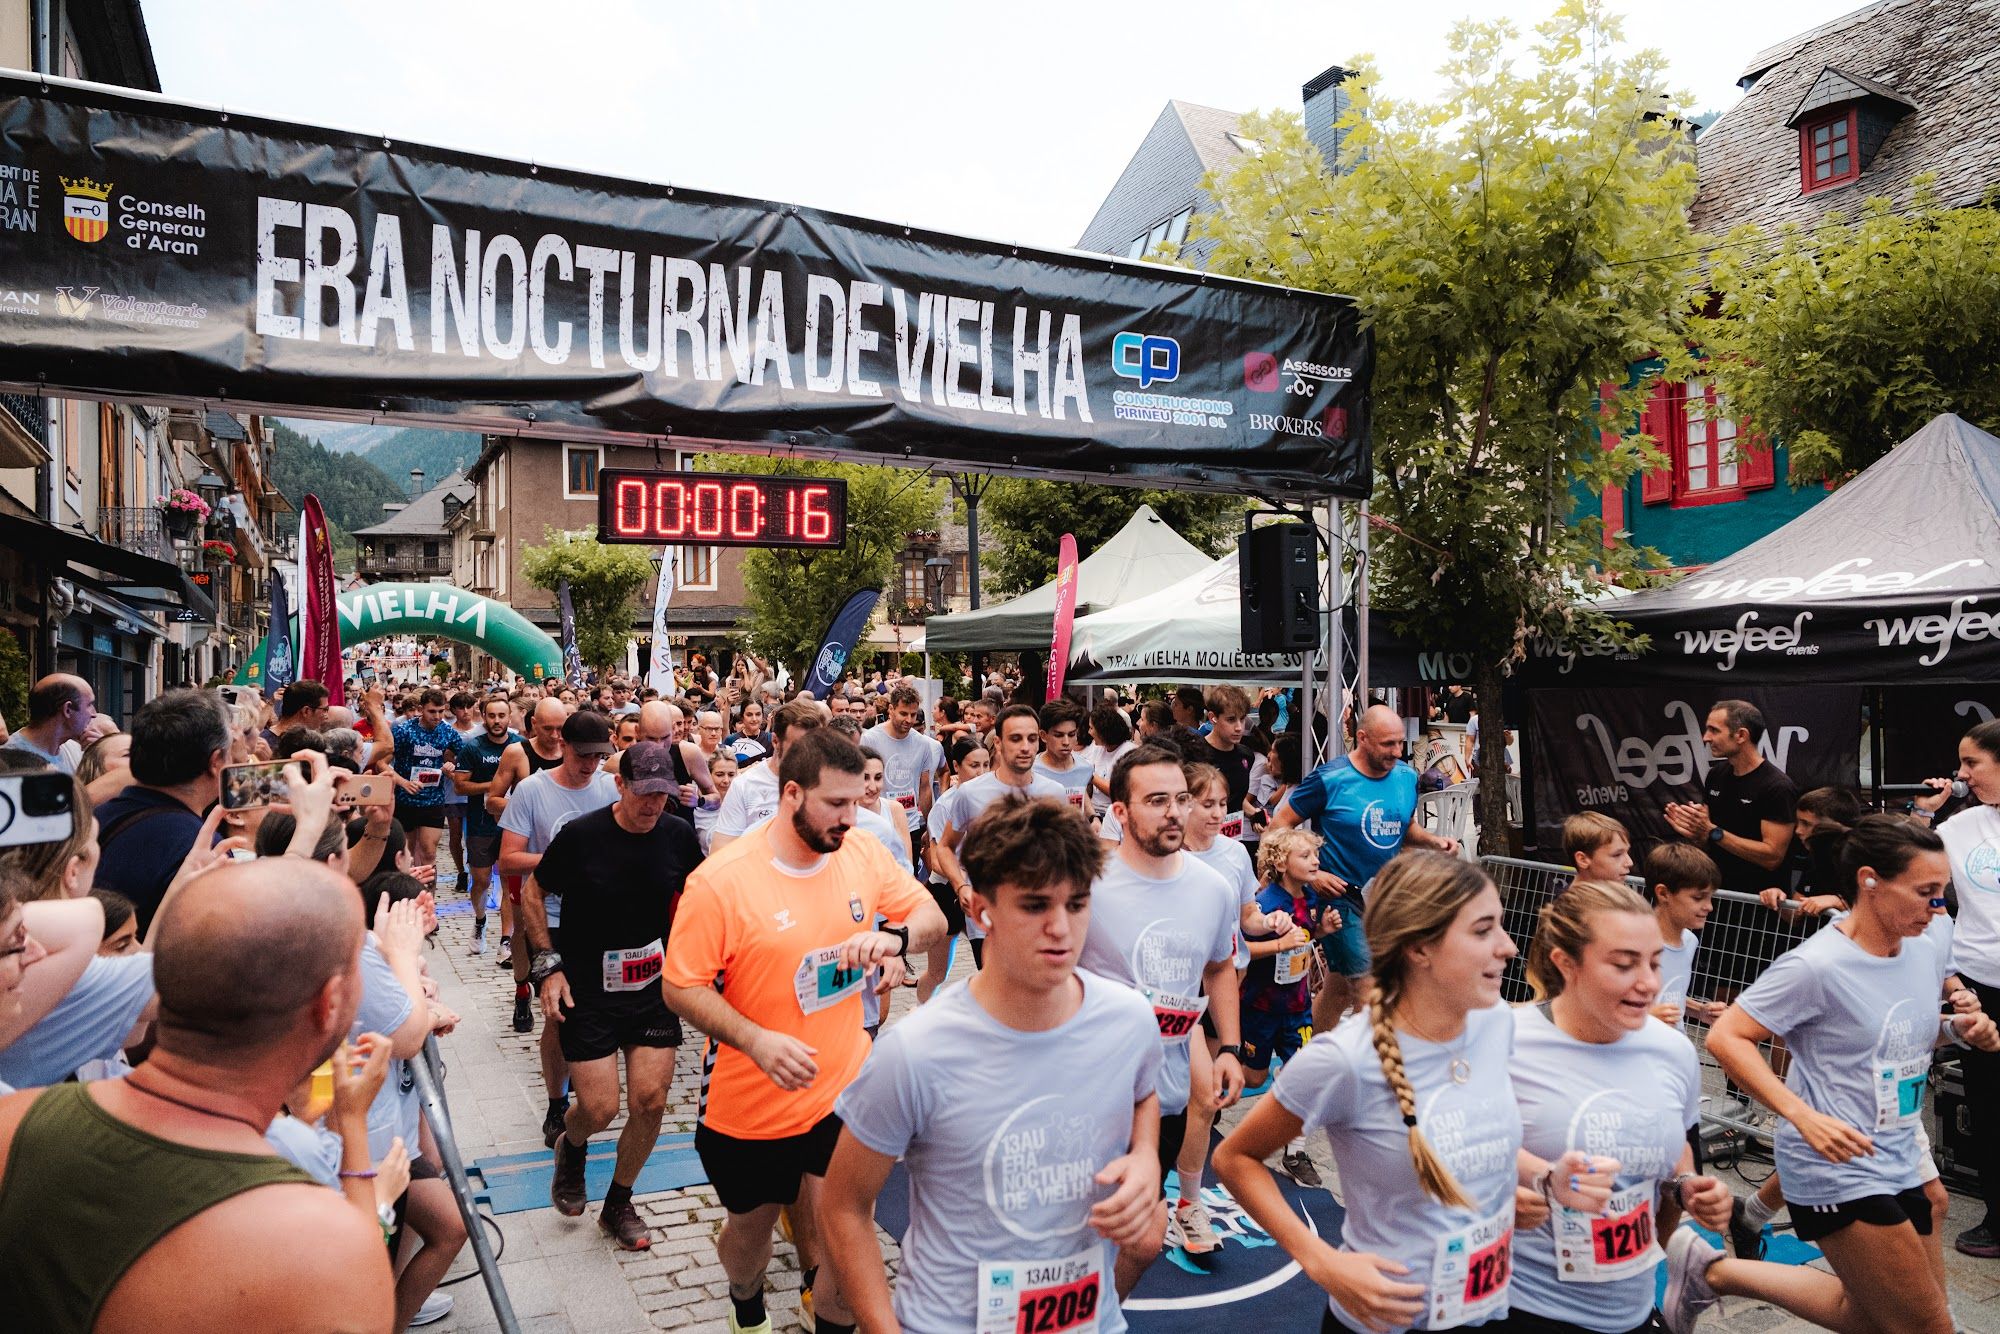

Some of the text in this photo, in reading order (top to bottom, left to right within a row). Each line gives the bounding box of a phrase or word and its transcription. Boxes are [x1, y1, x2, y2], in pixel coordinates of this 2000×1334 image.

[22, 168, 40, 183] DE
[28, 184, 40, 208] E
[119, 194, 206, 221] Conselh
[119, 214, 206, 238] Generau
[126, 232, 198, 256] d'Aran
[100, 293, 208, 319] Volentaris
[256, 195, 1095, 424] ERA NOCTURNA DE VIELHA
[1281, 357, 1352, 379] Assessors
[1113, 390, 1233, 416] CONSTRUCCIONS
[1114, 405, 1172, 422] PIRINEU
[1173, 410, 1207, 428] 2001
[1249, 413, 1323, 438] BROKERS
[617, 479, 830, 540] 00:00:16
[1687, 557, 1985, 603] wefeel
[336, 588, 488, 640] VIELHA
[1674, 610, 1813, 672] wefeel
[1785, 643, 1820, 656] events
[1106, 655, 1138, 668] TRAIL
[1143, 650, 1191, 667] VIELHA
[1195, 648, 1275, 668] MOLIÈRES
[624, 950, 643, 960] 13AU
[624, 957, 661, 982] 1195
[1156, 1012, 1197, 1035] 1281
[1584, 1111, 1622, 1131] 13AU
[1001, 1127, 1046, 1155] 13AU
[1584, 1130, 1617, 1148] ERA
[1003, 1151, 1039, 1178] ERA
[1003, 1157, 1095, 1193] NOCTURNA
[1004, 1191, 1028, 1213] DE
[1598, 1211, 1651, 1260] 1210
[1026, 1265, 1062, 1285] 13AU
[1020, 1283, 1099, 1334] 1209
